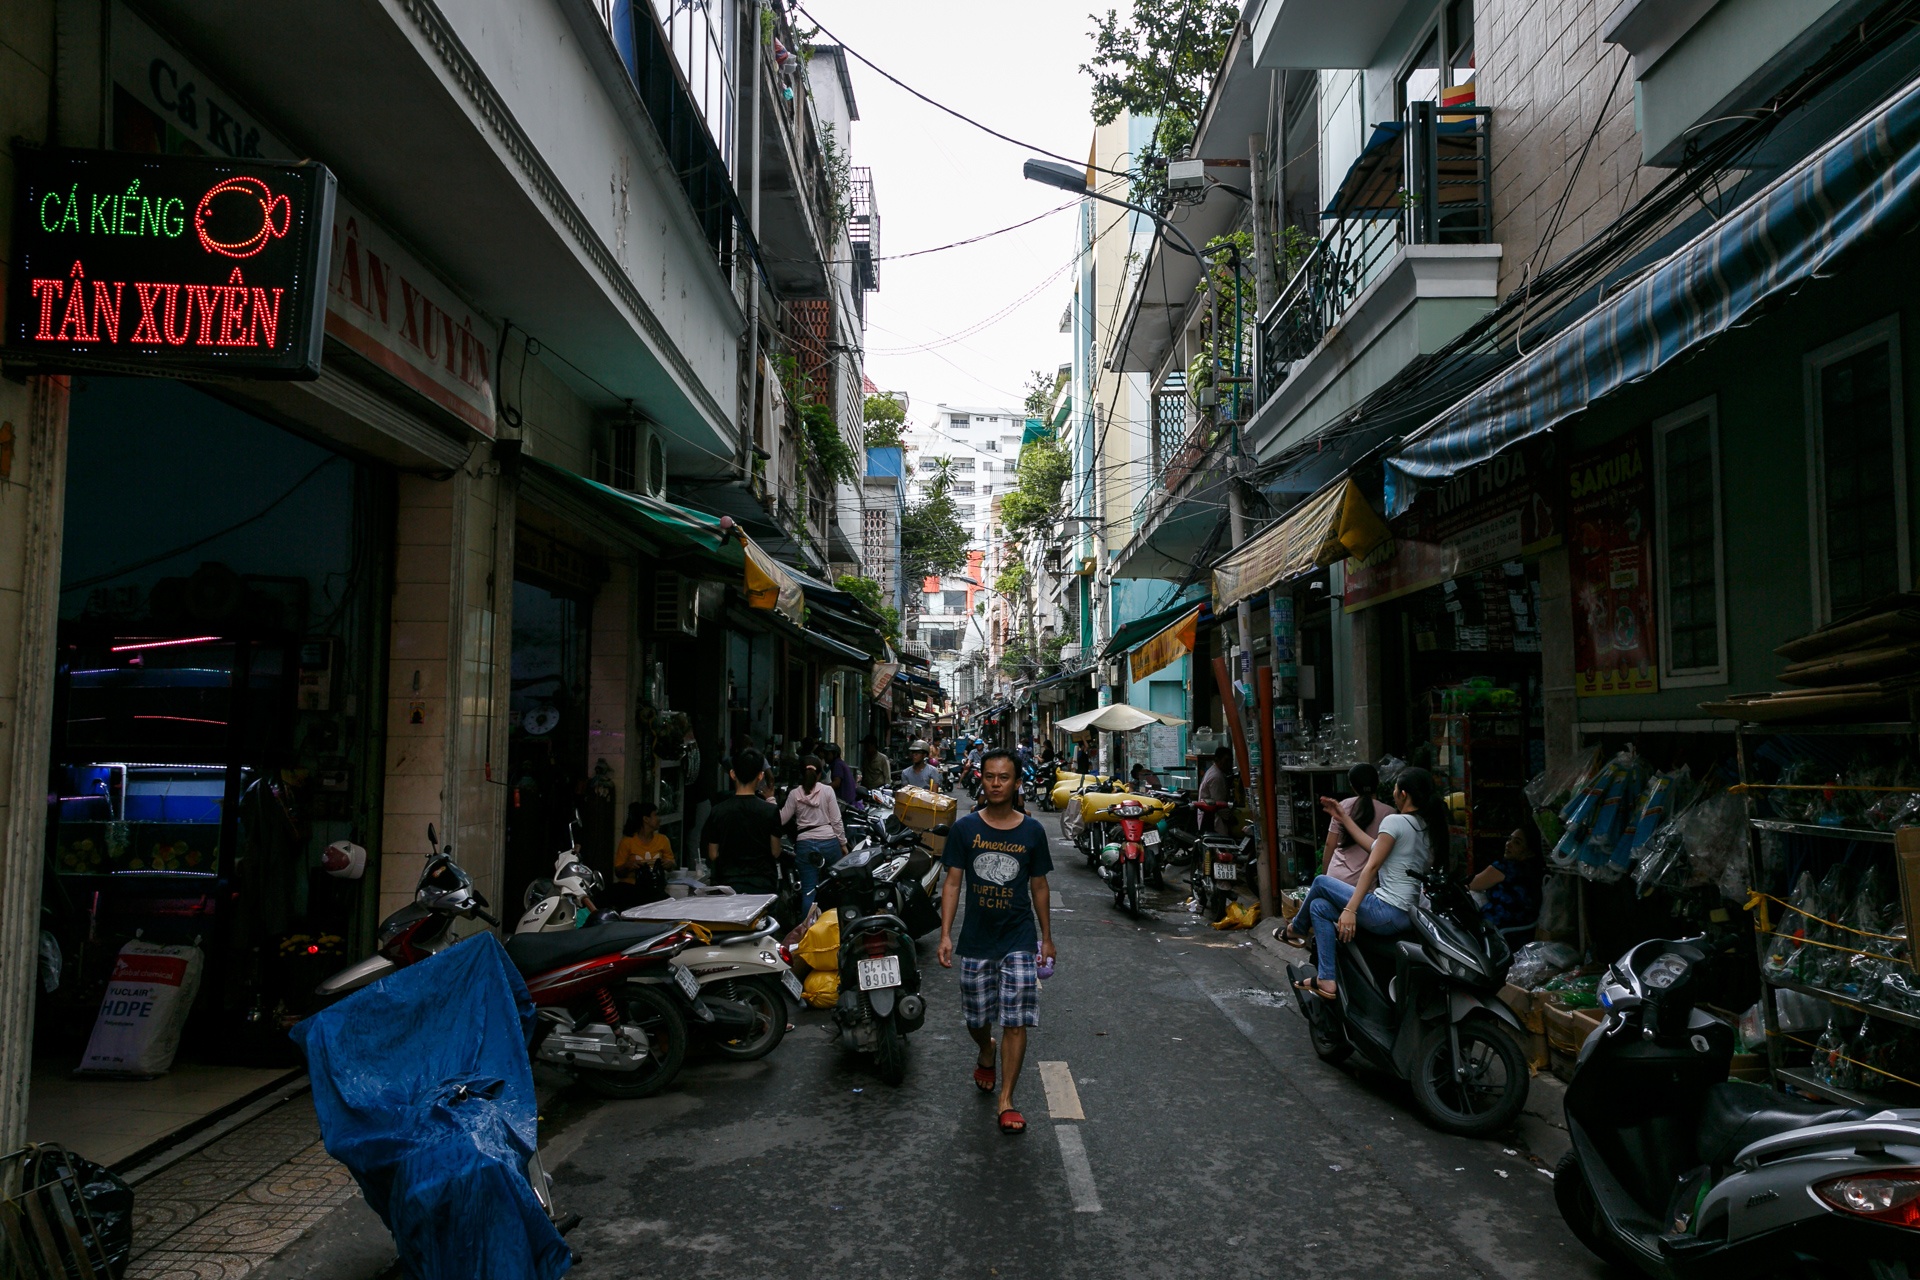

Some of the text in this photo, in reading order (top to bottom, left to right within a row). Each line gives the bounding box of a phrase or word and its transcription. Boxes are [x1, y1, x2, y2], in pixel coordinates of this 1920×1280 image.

[149, 58, 198, 130] Cá
[40, 179, 185, 239] CÁ KIỂNG
[30, 259, 285, 349] TÂN XUYÊN
[398, 314, 491, 391] XUYÊN
[1437, 474, 1471, 517] KIM
[1478, 450, 1526, 497] HOA
[1570, 447, 1643, 499] SAKURA
[972, 833, 1026, 853] American
[972, 884, 1014, 898] TURTLES
[110, 987, 149, 997] YUCLAIR
[140, 970, 173, 980] chemical
[866, 972, 894, 987] 8906
[101, 1000, 153, 1017] HDPE
